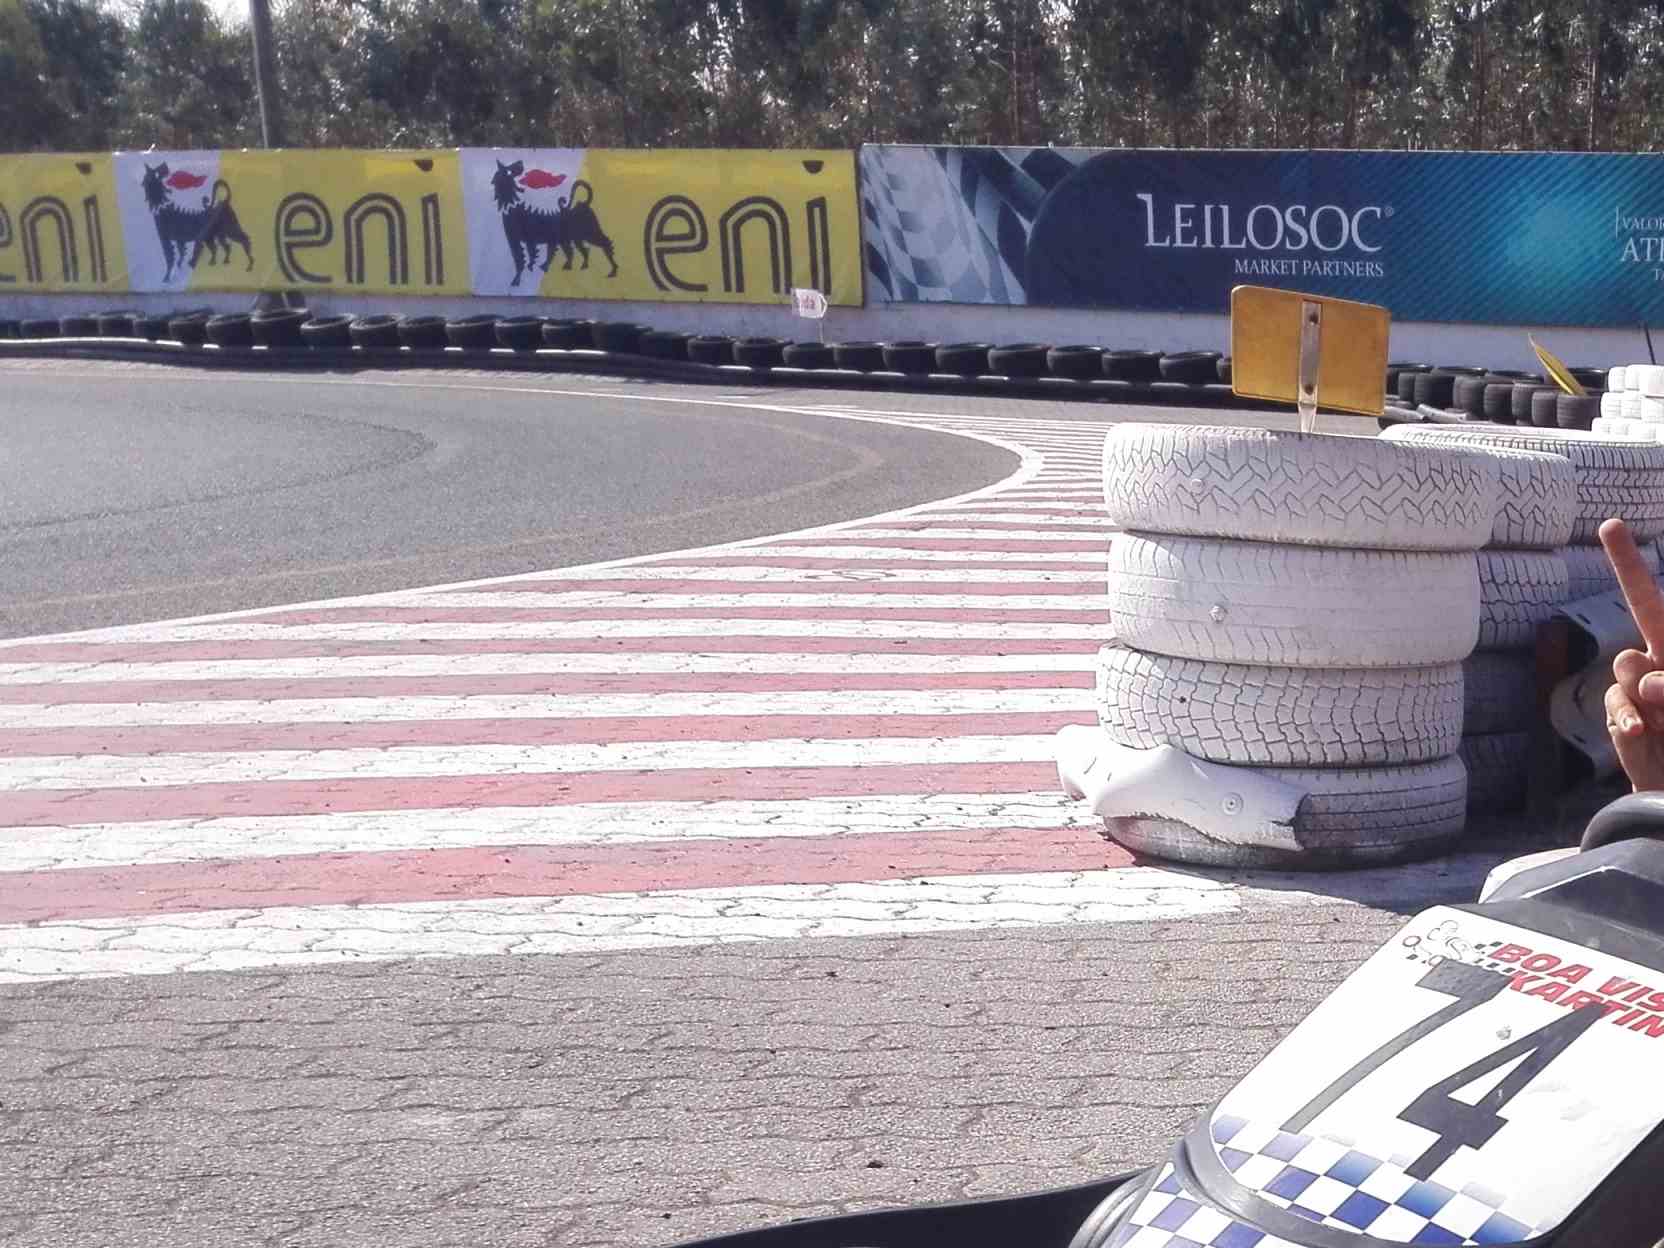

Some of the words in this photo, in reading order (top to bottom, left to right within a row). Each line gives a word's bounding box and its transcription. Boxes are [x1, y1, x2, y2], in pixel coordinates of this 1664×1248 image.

[0, 162, 108, 283] ni
[275, 159, 445, 285] eni
[643, 160, 832, 296] eni
[1234, 258, 1299, 275] MARKET
[1303, 259, 1385, 277] PARTNERS
[1488, 943, 1594, 985] BOA
[1279, 957, 1603, 1182] 74
